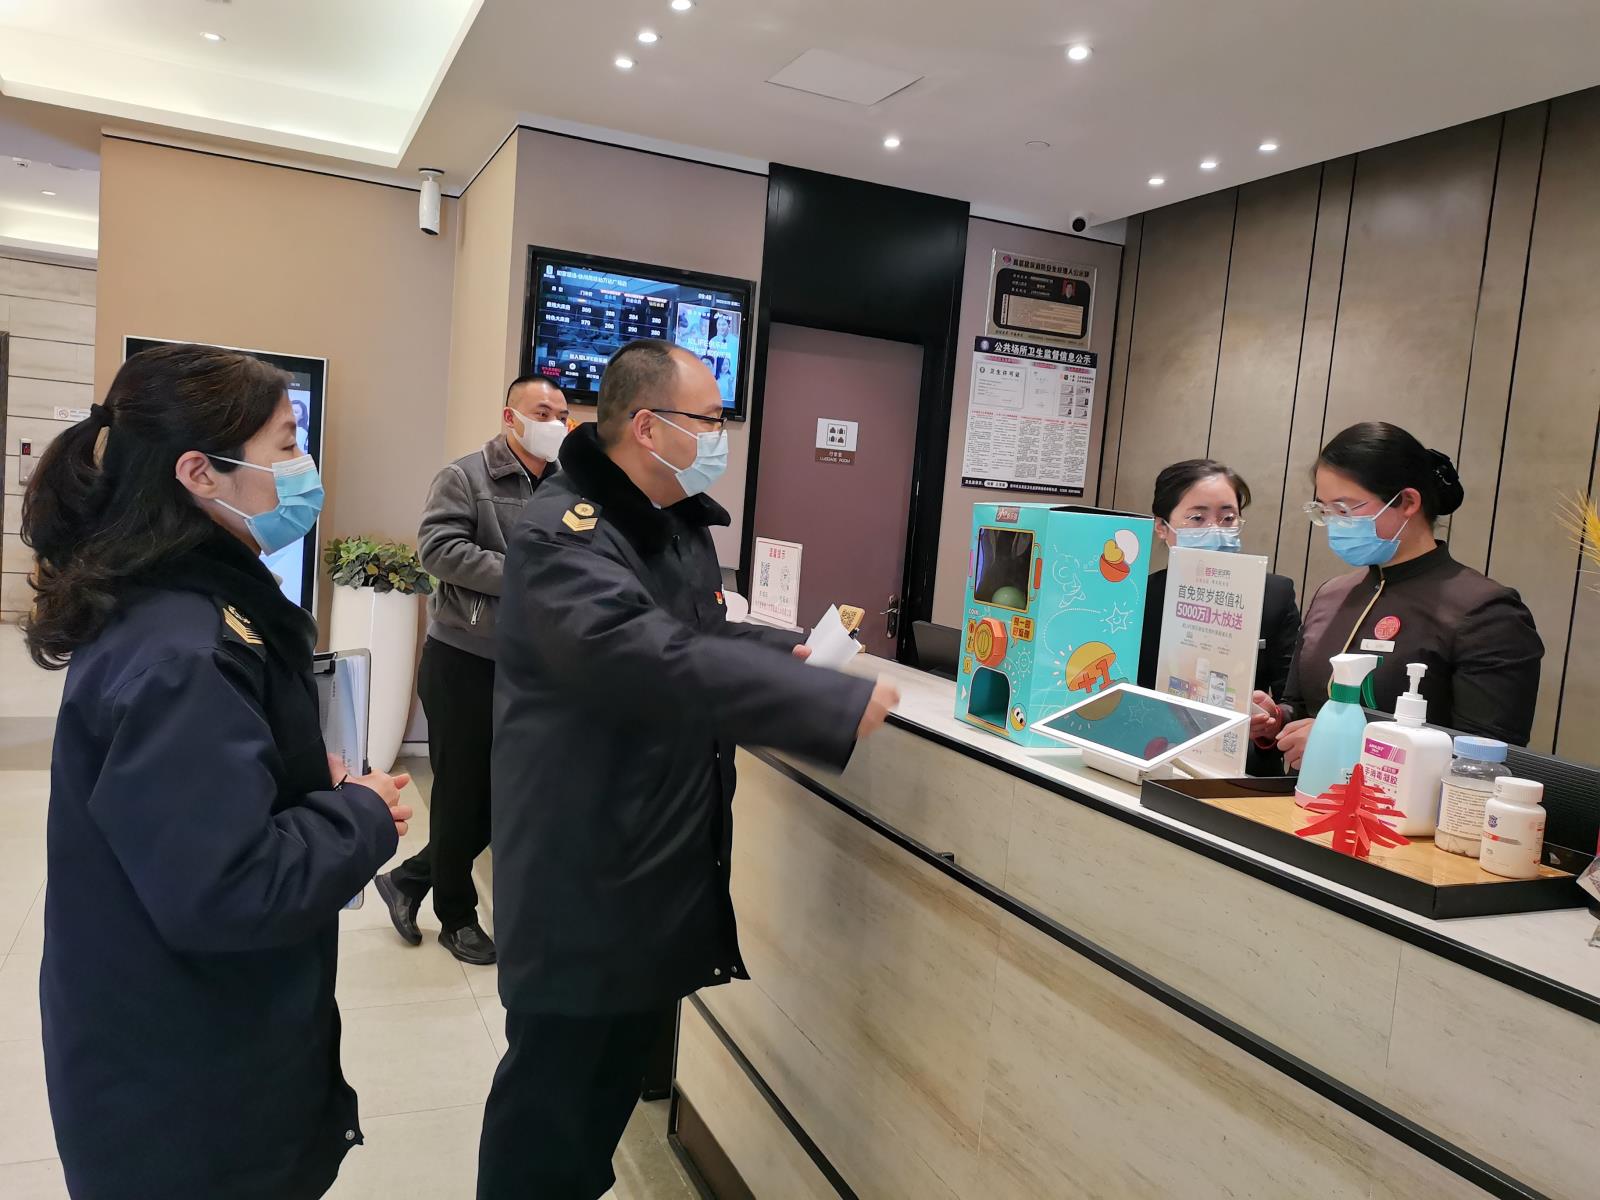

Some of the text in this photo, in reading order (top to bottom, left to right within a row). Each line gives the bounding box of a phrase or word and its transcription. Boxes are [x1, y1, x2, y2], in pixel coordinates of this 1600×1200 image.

[994, 341, 1092, 366] 公共场所卫生监督信息公示
[1178, 584, 1245, 610] 首免贺岁超值礼
[1211, 609, 1243, 631] 大放送
[1365, 766, 1398, 785] 手消毒凝胶
